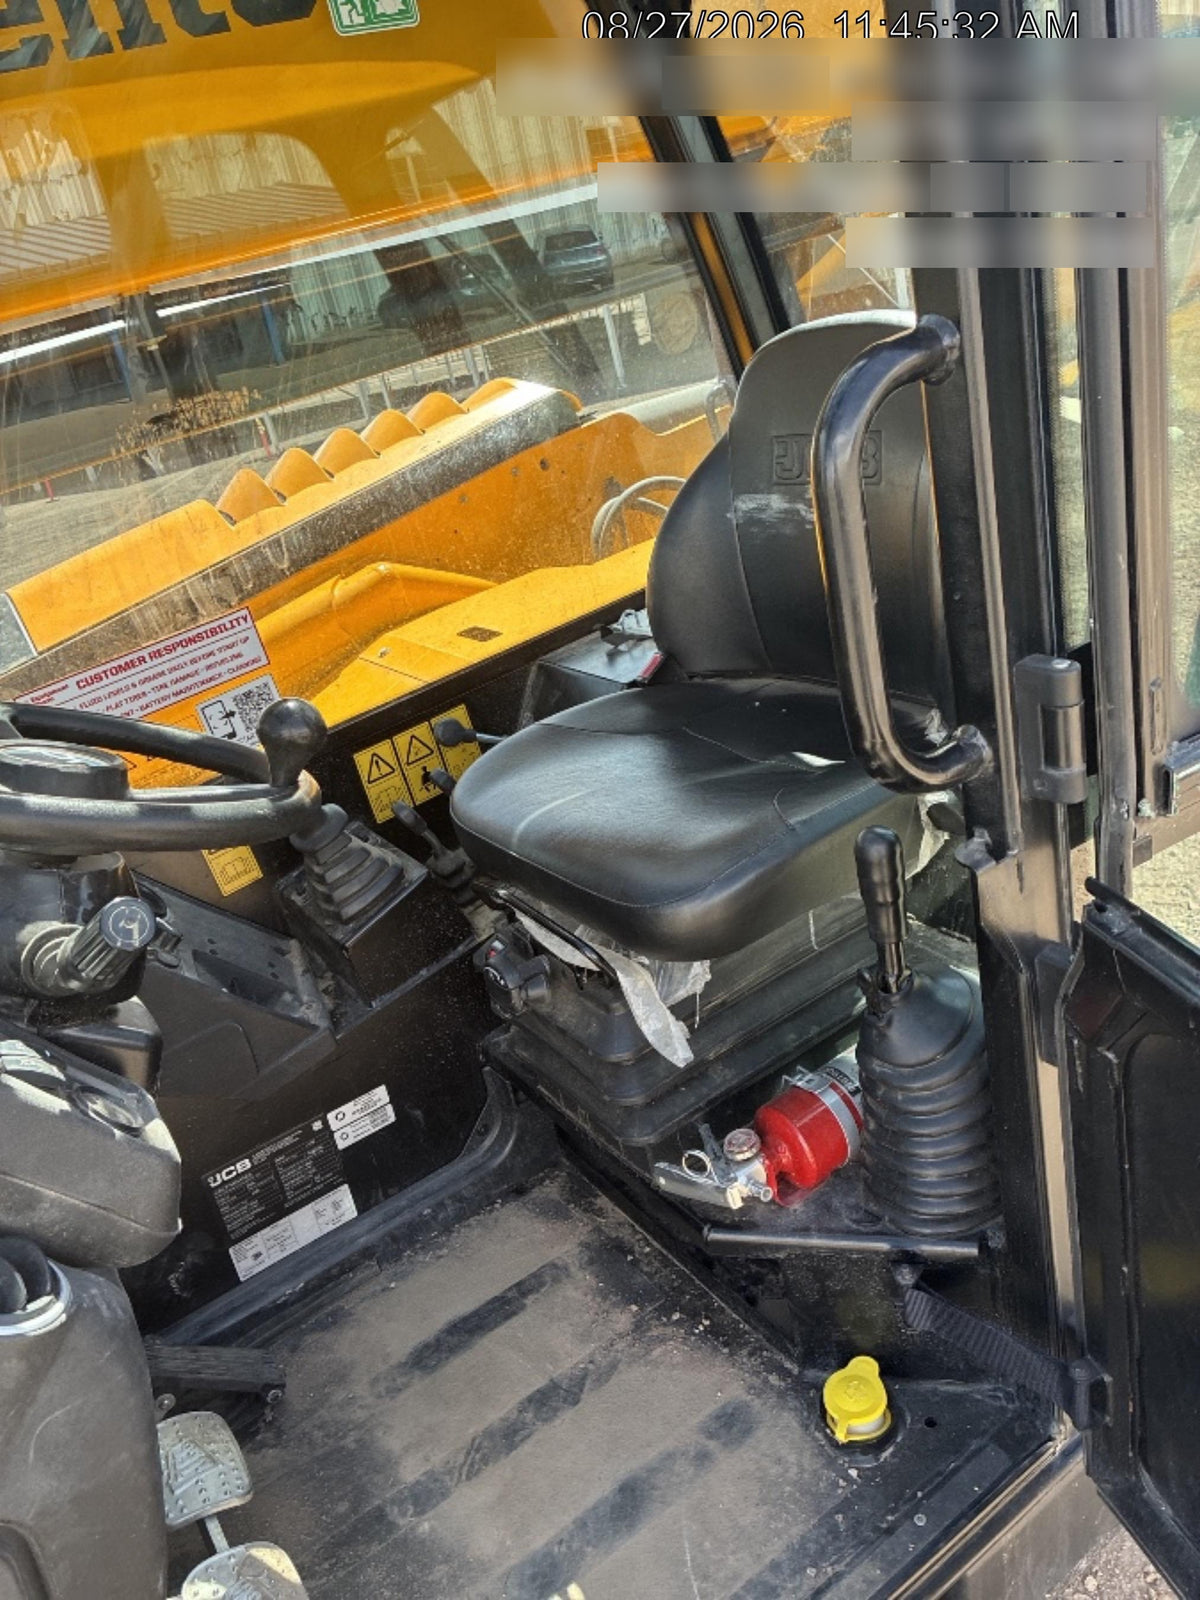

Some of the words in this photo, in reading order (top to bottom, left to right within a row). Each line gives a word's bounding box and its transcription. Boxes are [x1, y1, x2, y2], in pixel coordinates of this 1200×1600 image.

[775, 437, 878, 481] JB
[76, 655, 147, 690] CUSTOMER
[148, 614, 248, 662] RESPONSIBILITY
[207, 1158, 252, 1188] JCB
